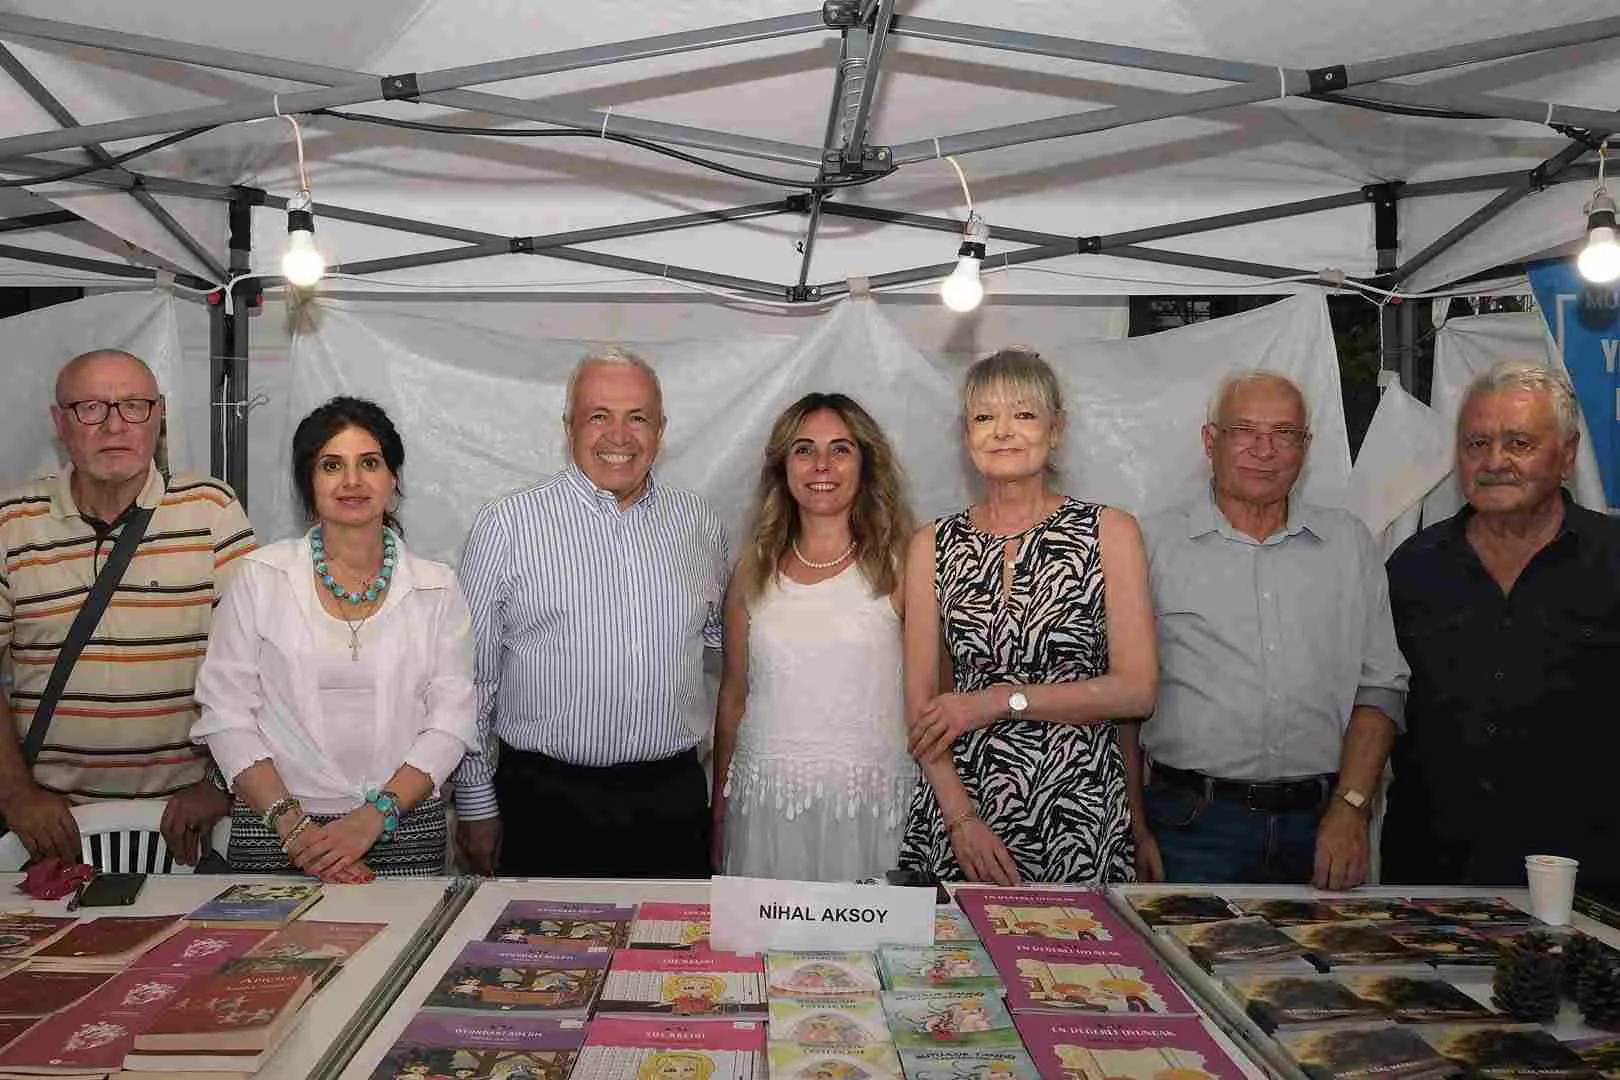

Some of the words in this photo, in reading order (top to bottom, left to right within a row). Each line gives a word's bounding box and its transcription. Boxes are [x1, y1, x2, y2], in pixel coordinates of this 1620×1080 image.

[1600, 338, 1620, 374] Y
[759, 902, 816, 921] NİHAL
[821, 908, 889, 923] AKSOY
